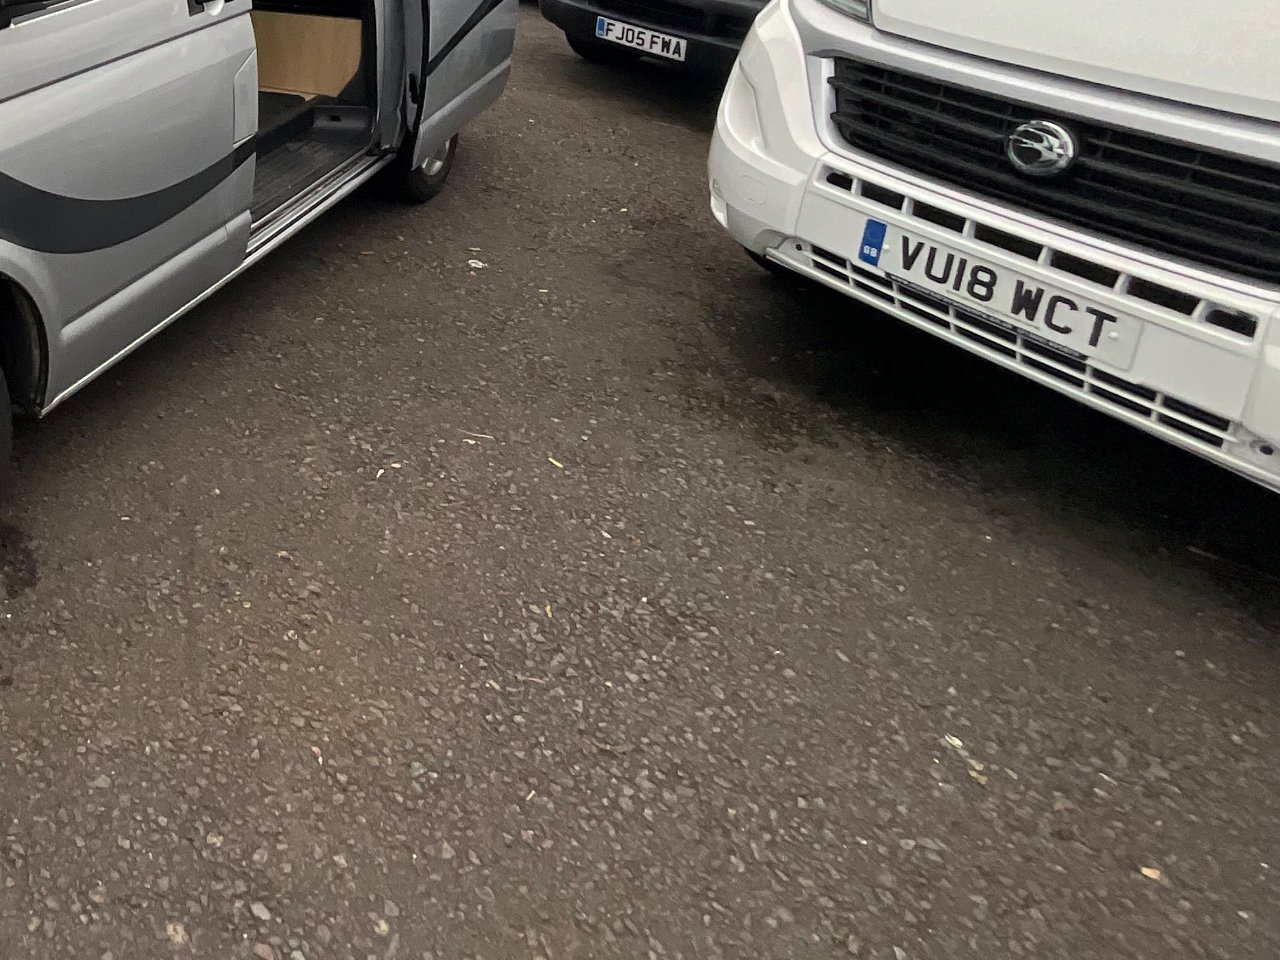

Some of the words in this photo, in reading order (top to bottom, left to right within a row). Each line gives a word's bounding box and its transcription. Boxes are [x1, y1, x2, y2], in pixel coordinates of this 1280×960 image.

[605, 22, 646, 47] FJ05
[649, 34, 682, 57] FWA
[901, 235, 997, 302] VU18
[1010, 279, 1117, 347] WCT
